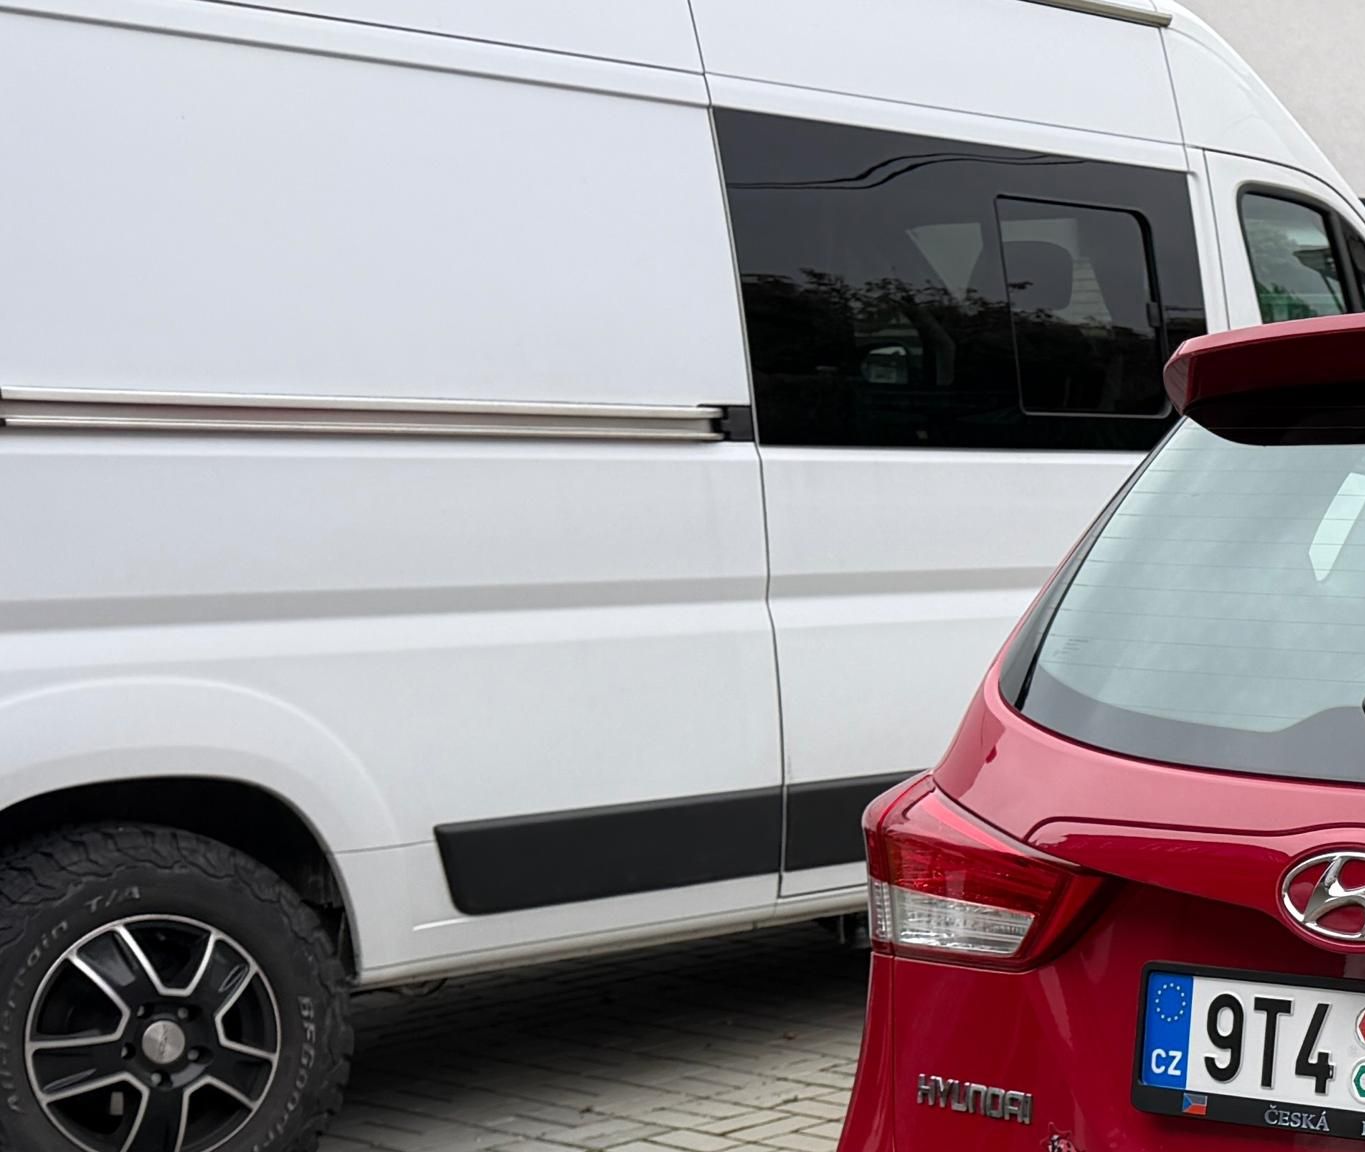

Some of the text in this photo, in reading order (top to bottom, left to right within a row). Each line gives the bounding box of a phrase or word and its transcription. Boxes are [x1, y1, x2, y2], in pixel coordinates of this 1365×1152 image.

[1150, 1048, 1182, 1076] CZ
[1203, 993, 1334, 1095] 9T4
[916, 1073, 1033, 1125] HYUNDAI
[1264, 1105, 1330, 1133] ČESKÁ
